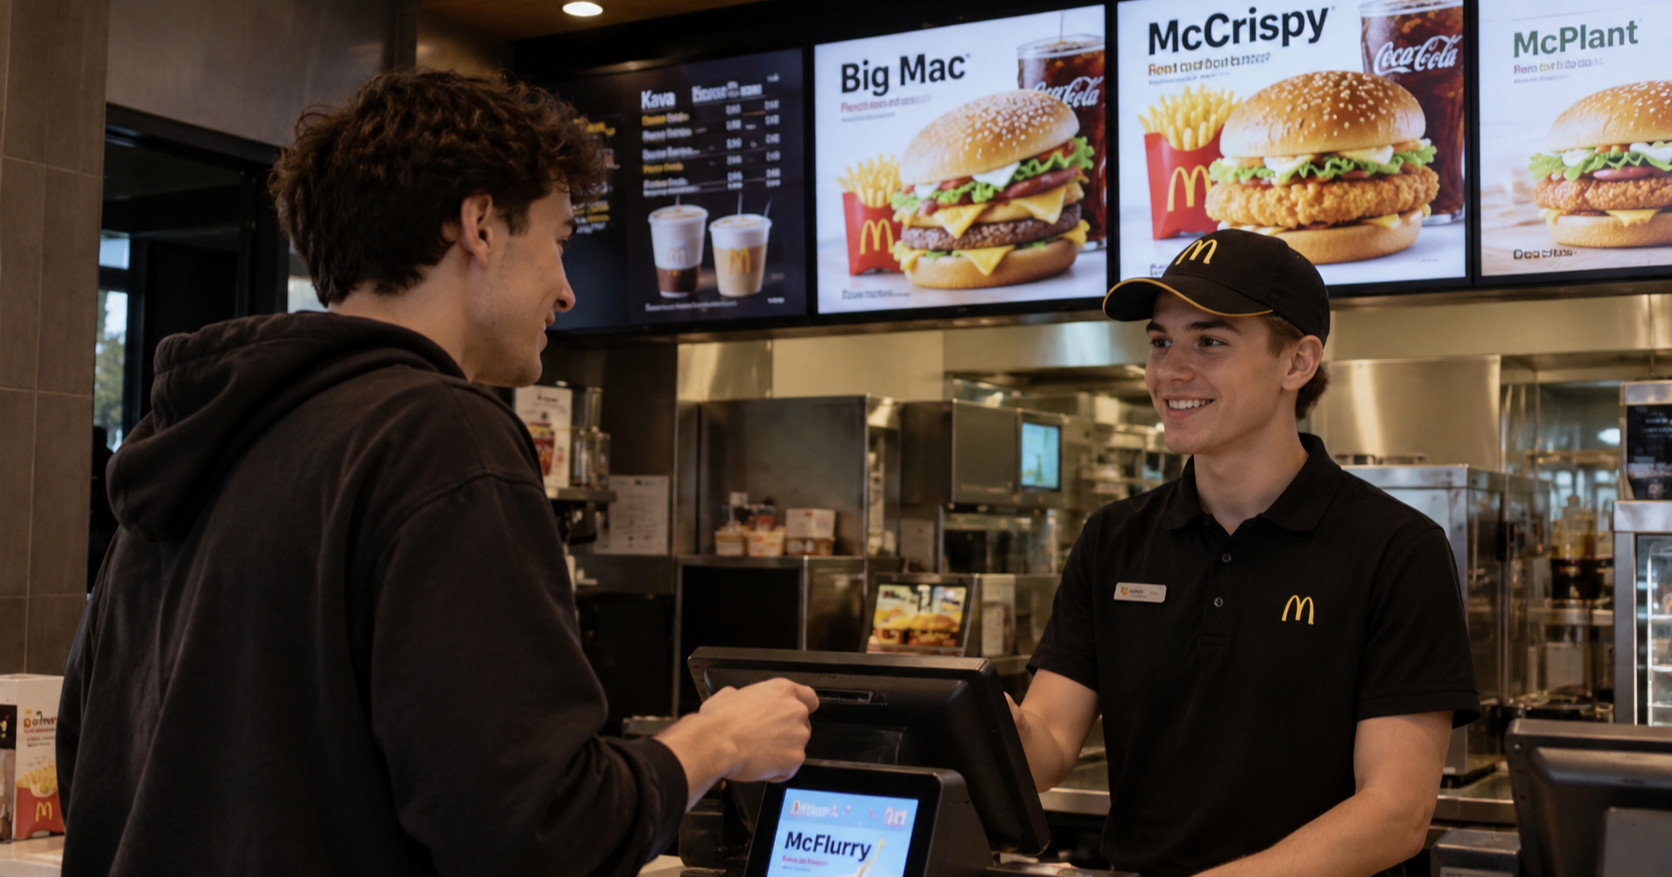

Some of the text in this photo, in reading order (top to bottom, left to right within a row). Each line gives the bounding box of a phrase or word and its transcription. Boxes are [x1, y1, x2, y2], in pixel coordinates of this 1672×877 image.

[1148, 7, 1329, 55] McCrispy
[1513, 20, 1639, 58] McPlant
[841, 53, 966, 97] Big Mac
[641, 90, 676, 109] Kava
[784, 831, 872, 863] McFlurry
